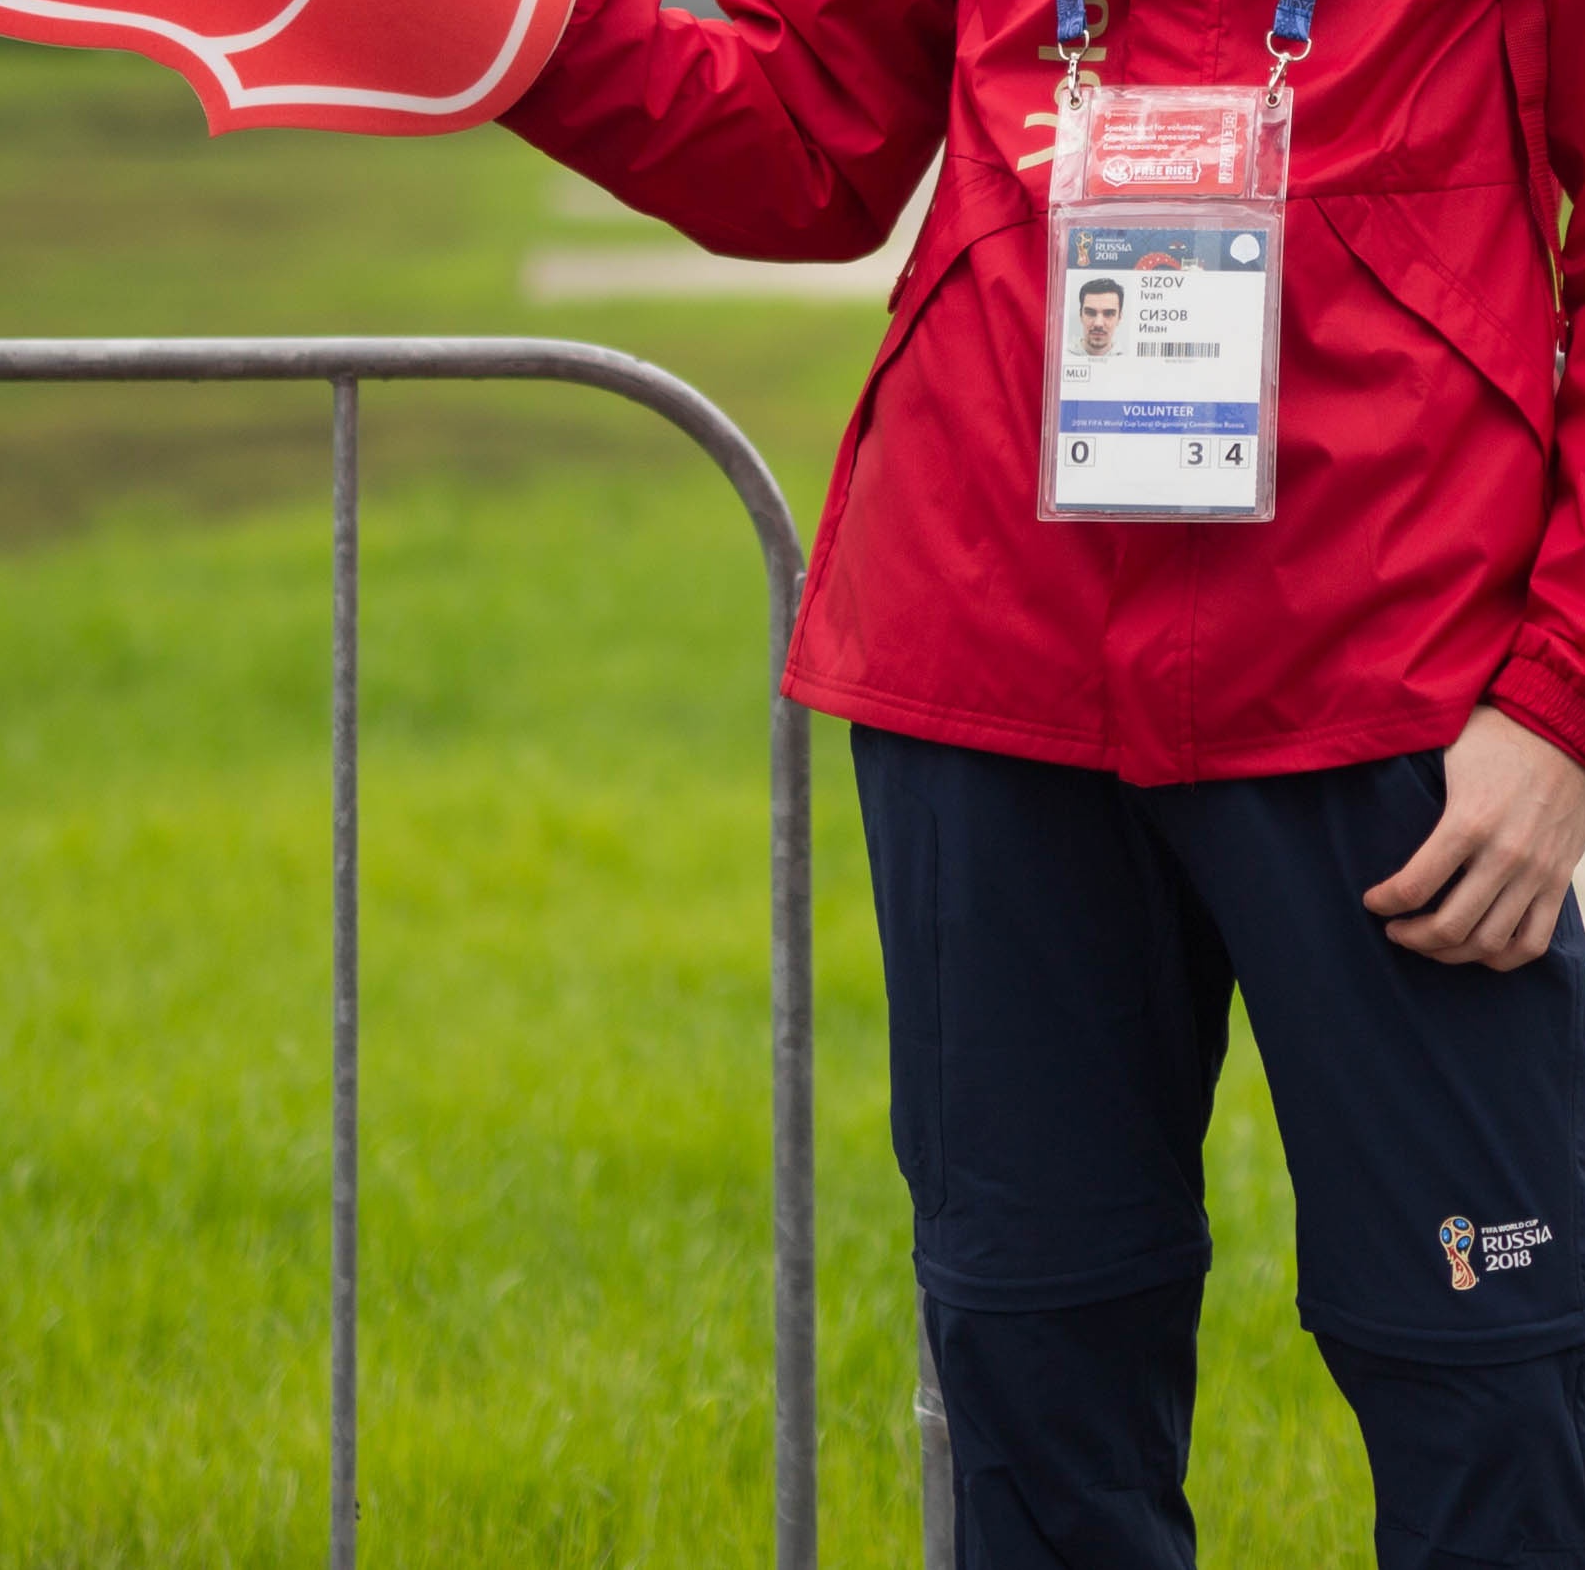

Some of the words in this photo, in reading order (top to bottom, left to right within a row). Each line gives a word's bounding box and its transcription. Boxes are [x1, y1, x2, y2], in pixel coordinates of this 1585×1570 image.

[1134, 164, 1163, 176] FREE
[1165, 164, 1193, 176] RIDE
[1095, 242, 1133, 253] RUSSIA
[1095, 252, 1119, 261] 2018
[1141, 276, 1185, 289] SIZOV
[1140, 290, 1164, 301] Ivan
[1139, 309, 1188, 322] СИЗОВ
[1138, 323, 1168, 334] Иван
[1065, 368, 1088, 379] MLU
[1122, 405, 1195, 418] VOLUNTEER
[1187, 442, 1204, 466] 3
[1224, 442, 1244, 466] 4
[1498, 1222, 1524, 1232] WORLD
[1525, 1219, 1539, 1227] CUP
[1482, 1225, 1553, 1252] RUSSIA
[1485, 1250, 1532, 1271] 2018
